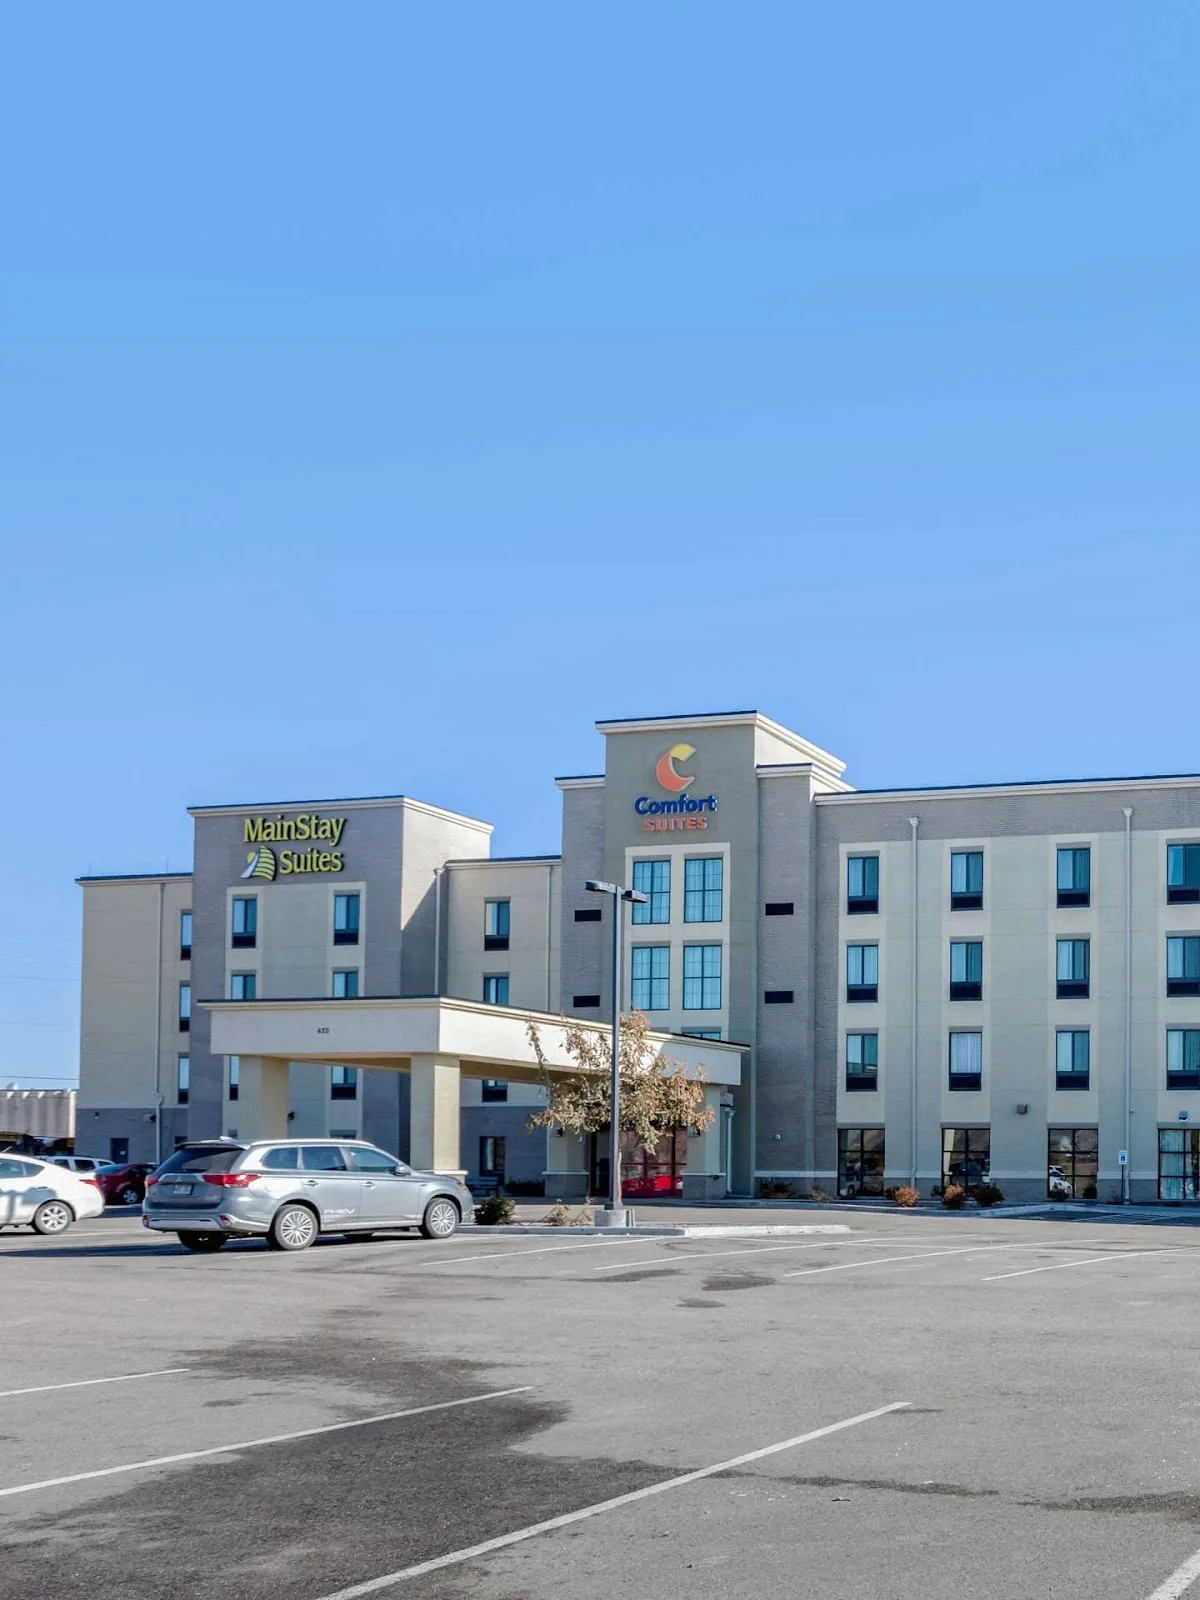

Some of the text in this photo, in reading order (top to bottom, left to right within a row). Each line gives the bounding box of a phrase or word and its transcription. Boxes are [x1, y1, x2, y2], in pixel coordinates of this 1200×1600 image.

[634, 793, 718, 815] Comfort
[243, 814, 345, 847] MainStay
[643, 816, 707, 832] SUITES
[280, 847, 344, 874] Suites
